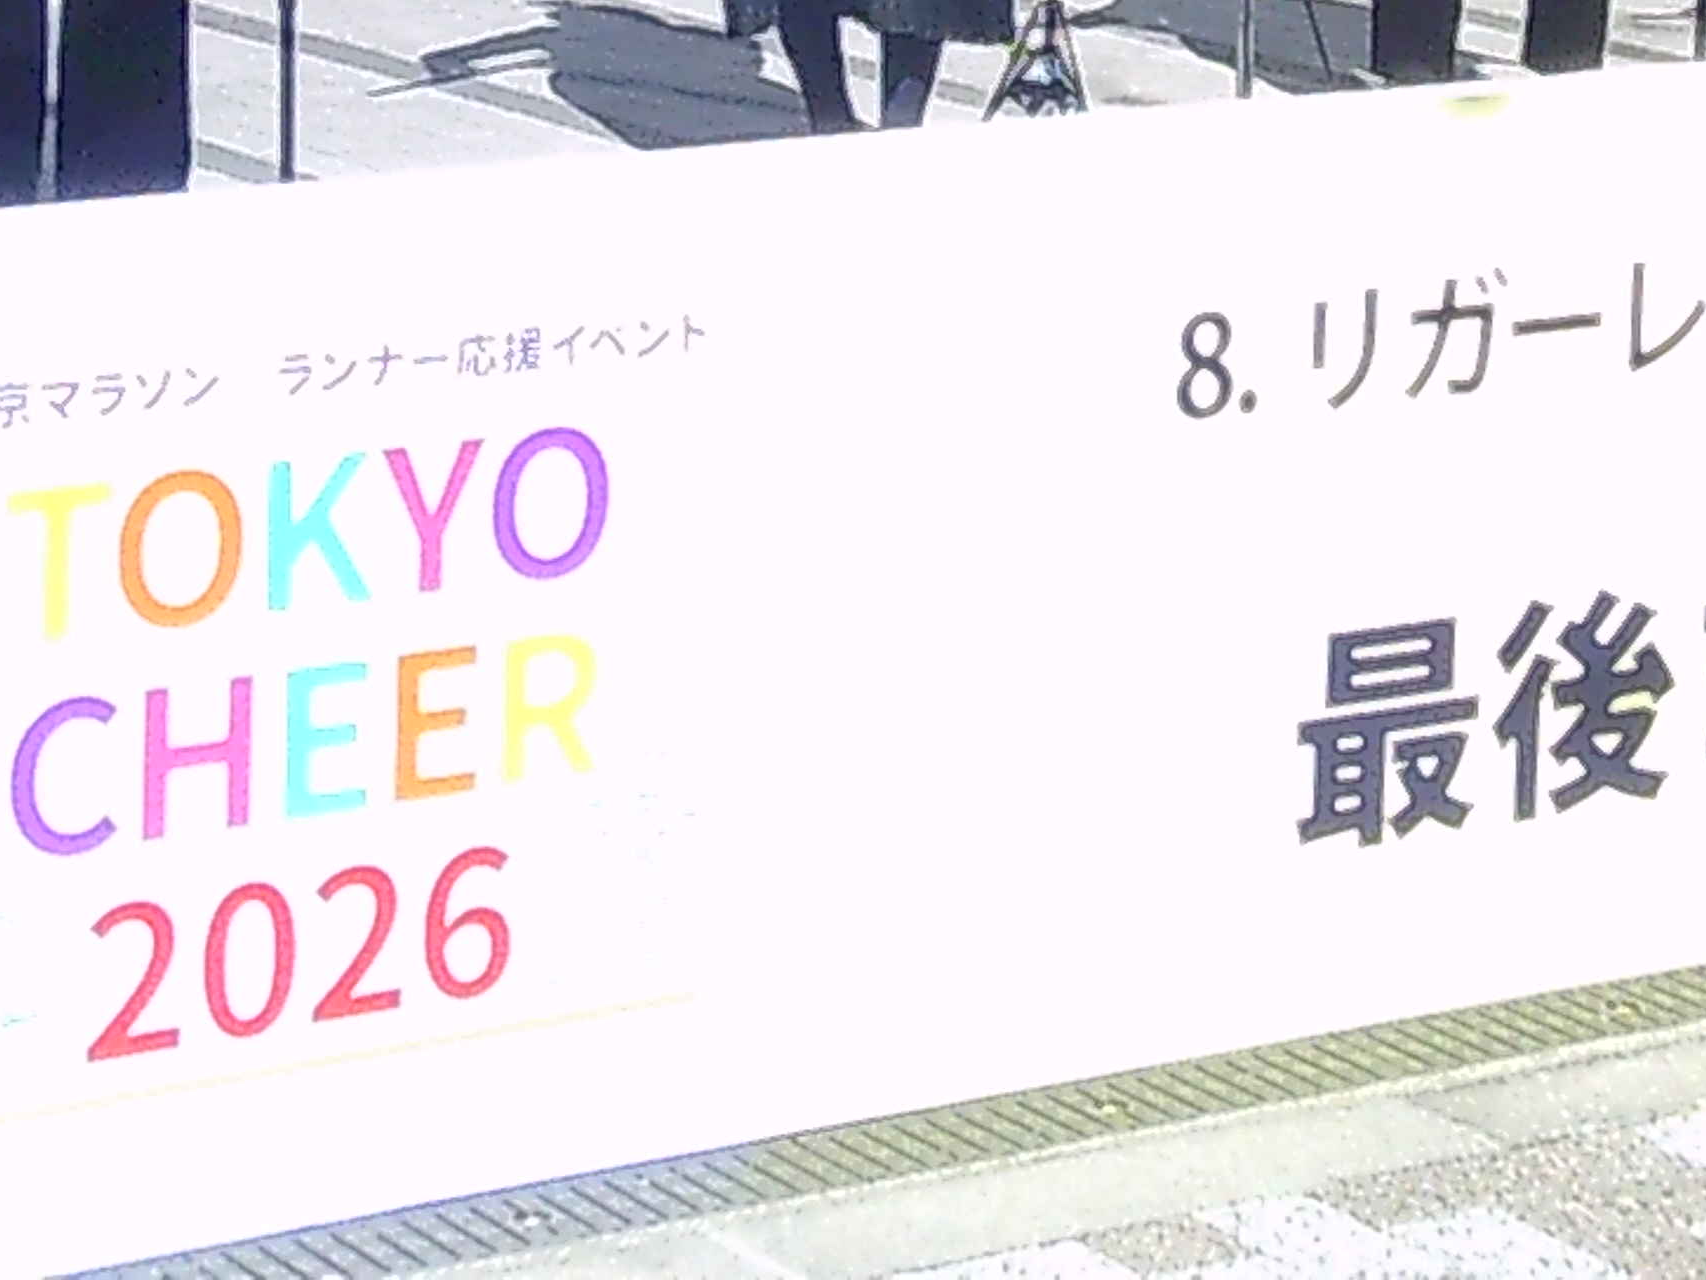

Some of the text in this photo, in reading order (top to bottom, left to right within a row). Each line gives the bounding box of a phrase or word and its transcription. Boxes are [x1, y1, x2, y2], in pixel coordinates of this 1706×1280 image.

[278, 314, 707, 395] ランナー応援イベント
[6, 426, 610, 641] TOKYO
[10, 633, 597, 857] CHEER
[85, 845, 512, 1064] 2026
